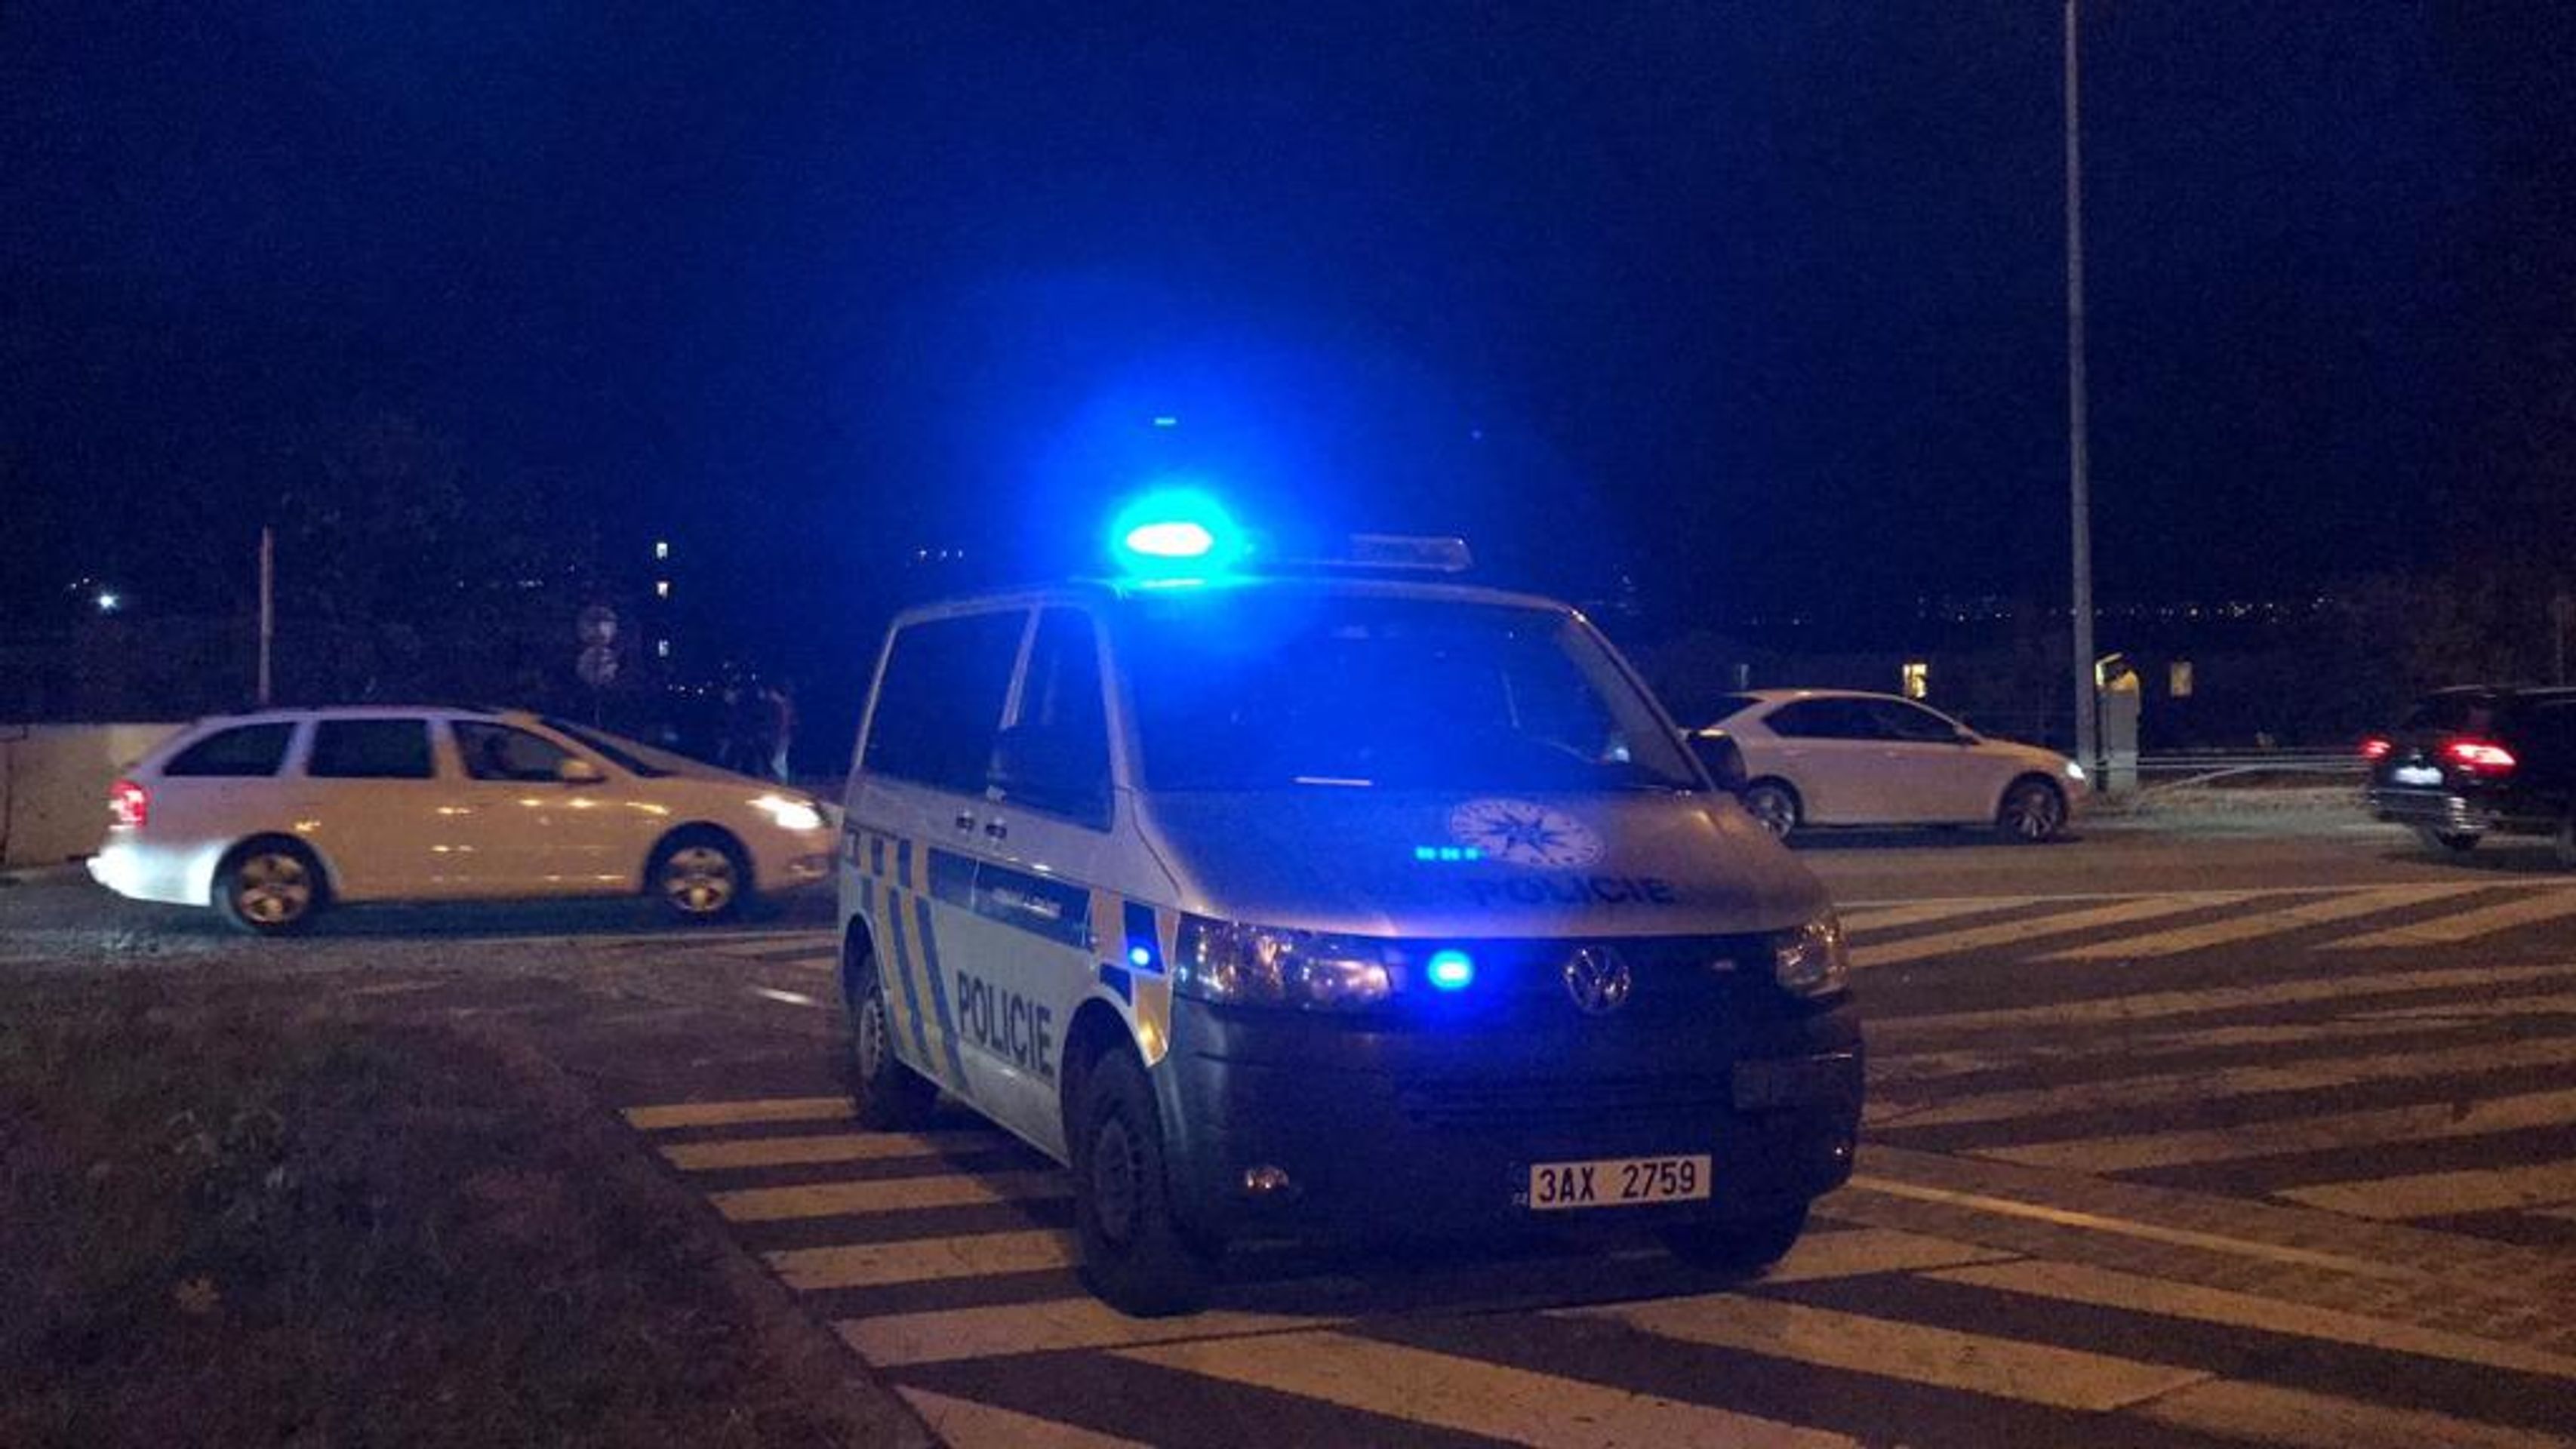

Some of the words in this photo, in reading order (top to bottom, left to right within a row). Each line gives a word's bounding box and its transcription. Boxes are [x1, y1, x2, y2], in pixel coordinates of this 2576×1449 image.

[958, 972, 1053, 1072] POLICIE
[1539, 1168, 1594, 1203] 3AX
[1621, 1160, 1696, 1199] 2759
